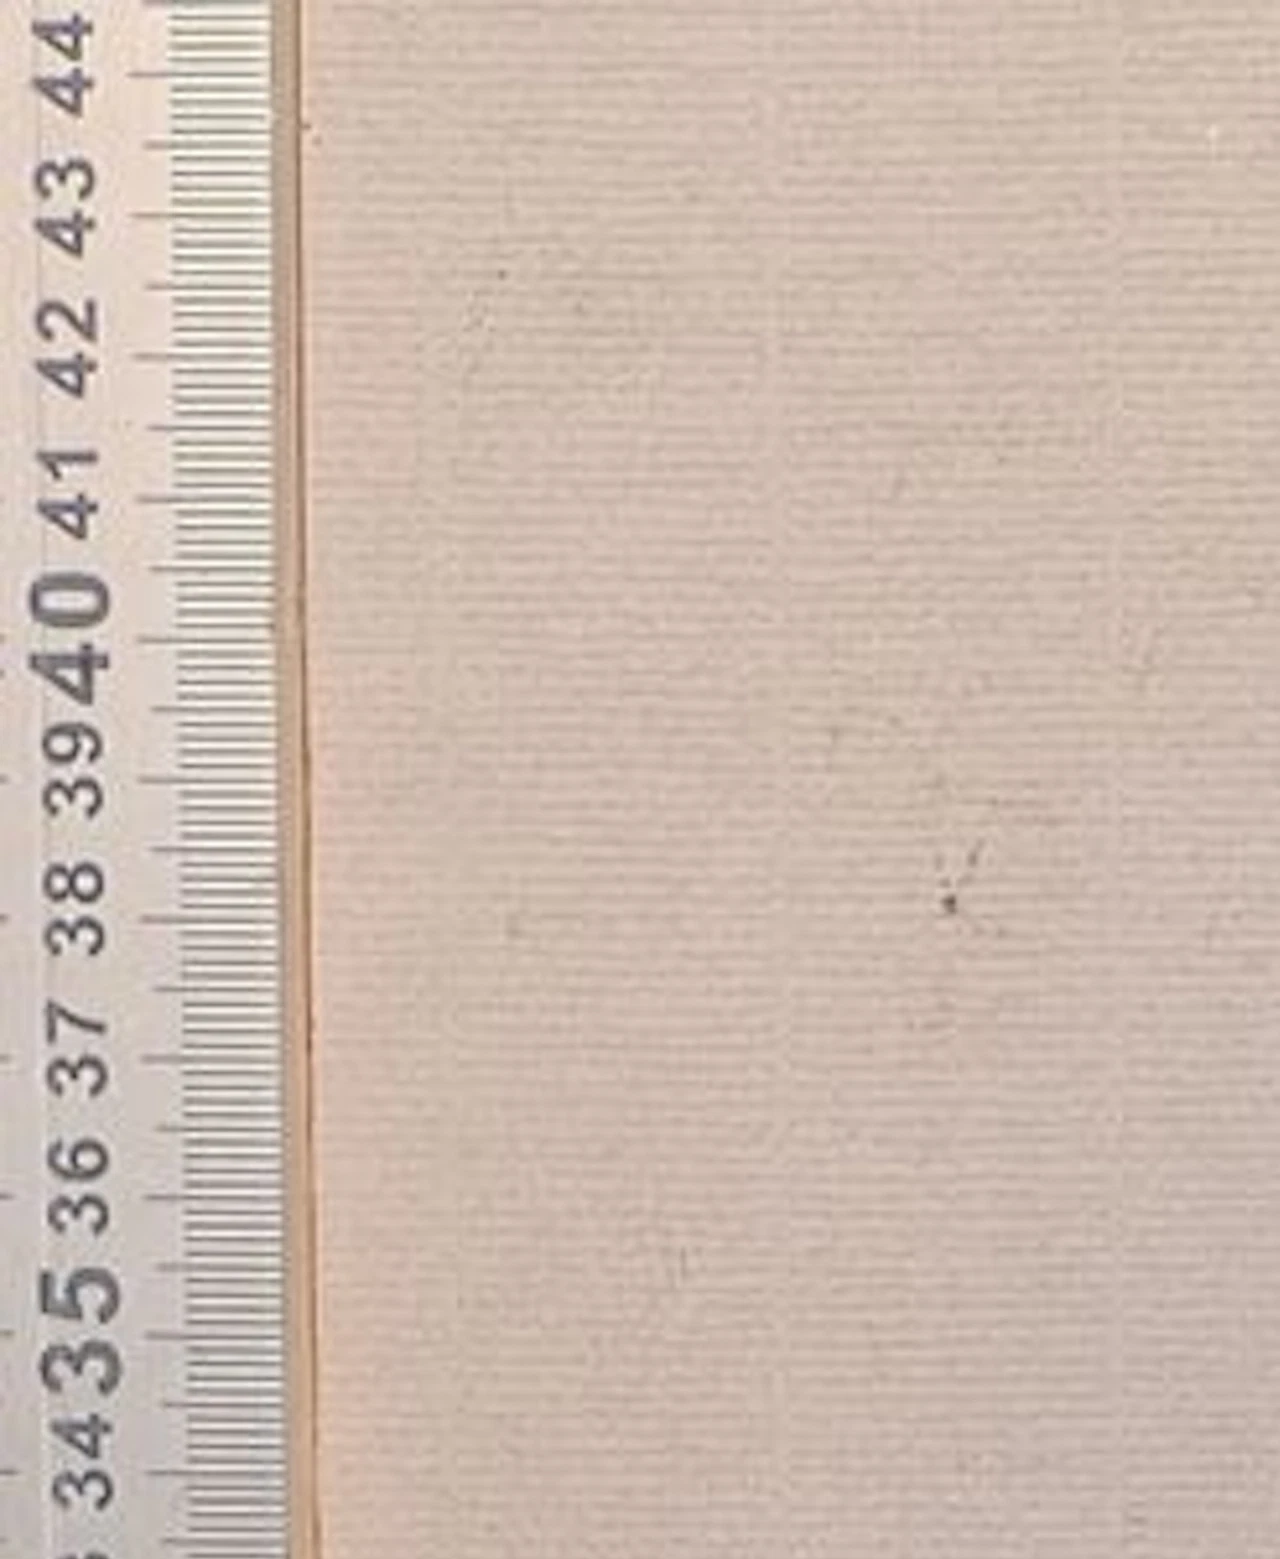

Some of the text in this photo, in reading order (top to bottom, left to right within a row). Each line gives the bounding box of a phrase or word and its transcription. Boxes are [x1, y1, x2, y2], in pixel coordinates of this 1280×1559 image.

[30, 12, 95, 118] 44
[33, 158, 96, 259] 43
[34, 298, 98, 399] 42
[35, 449, 99, 540] 41
[28, 572, 110, 706] 40
[41, 722, 104, 820] 39
[42, 861, 106, 957] 38
[44, 999, 109, 1098] 37
[47, 1138, 110, 1237] 36
[38, 1268, 122, 1396] 35
[50, 1413, 114, 1511] 34
